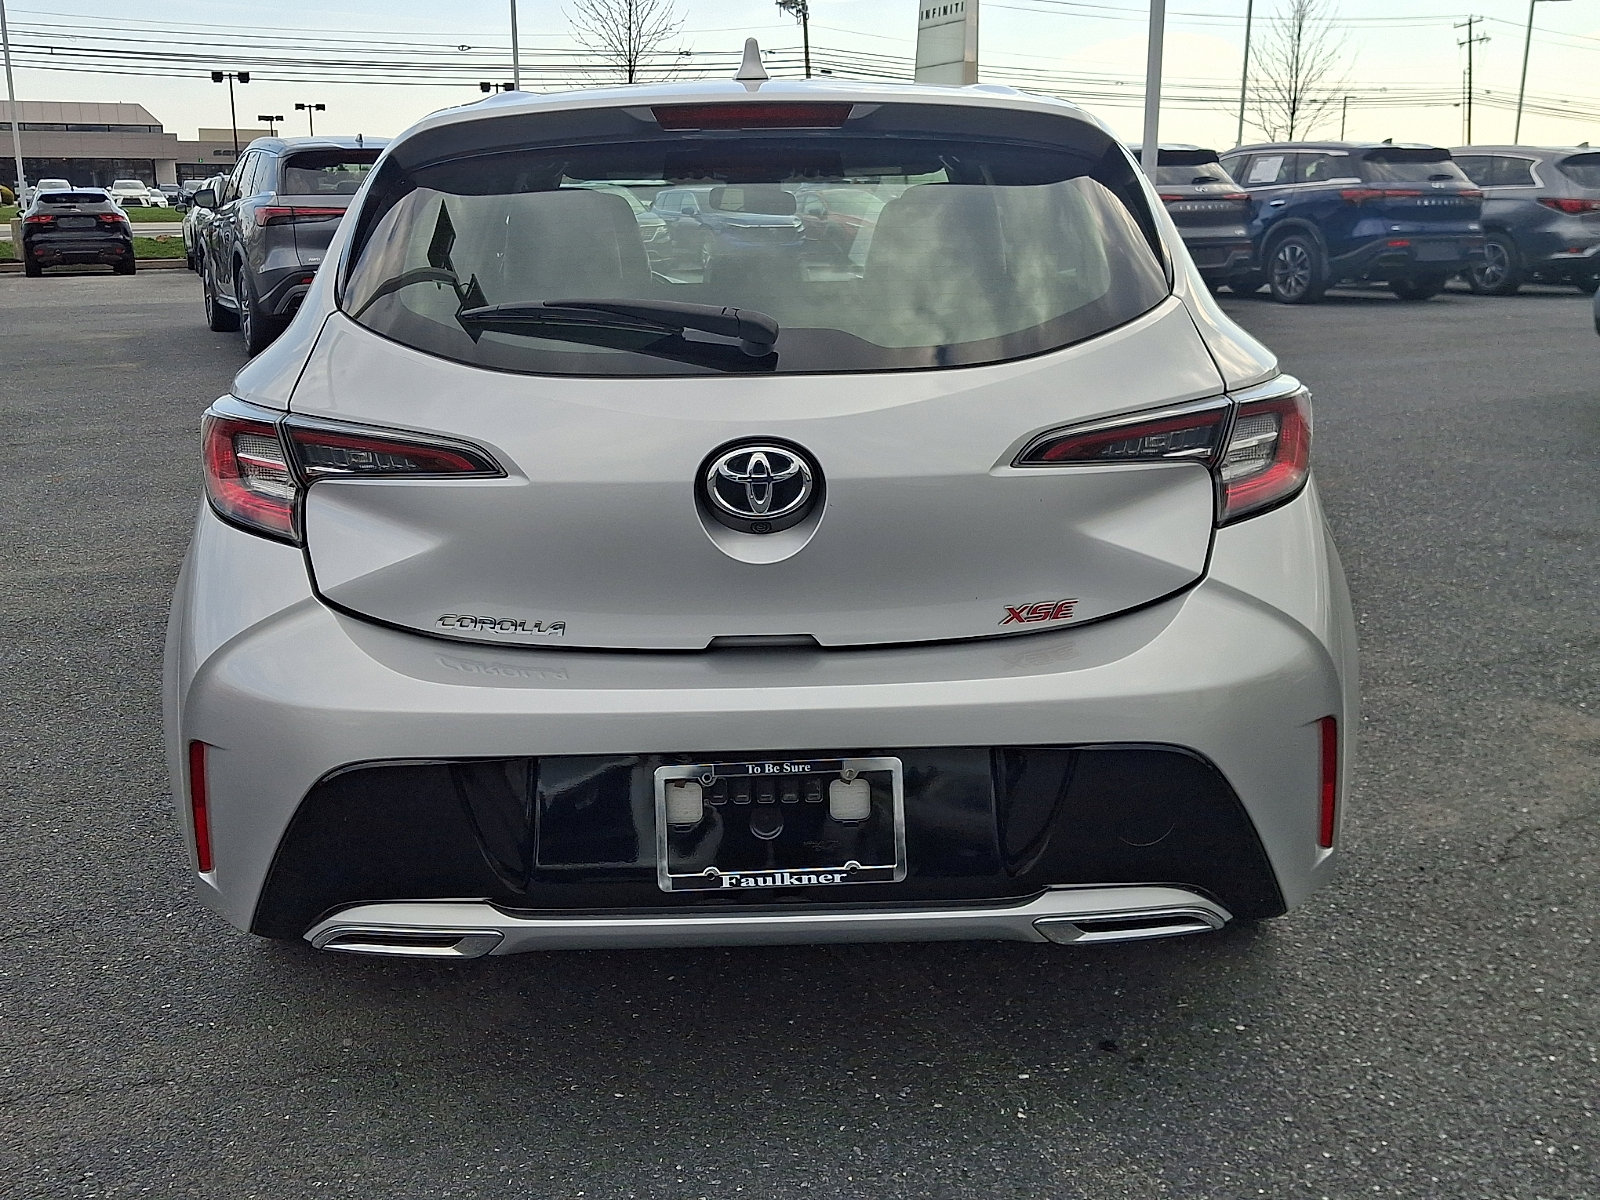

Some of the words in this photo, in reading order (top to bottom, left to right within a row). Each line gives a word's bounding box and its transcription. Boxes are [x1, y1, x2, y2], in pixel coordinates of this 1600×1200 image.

[920, 1, 964, 21] INFINITI
[998, 598, 1079, 626] XSE
[435, 613, 566, 637] COROLLA
[746, 764, 761, 774] To
[764, 763, 780, 773] Be
[783, 762, 811, 773] Sure
[720, 872, 847, 888] Faulkner
